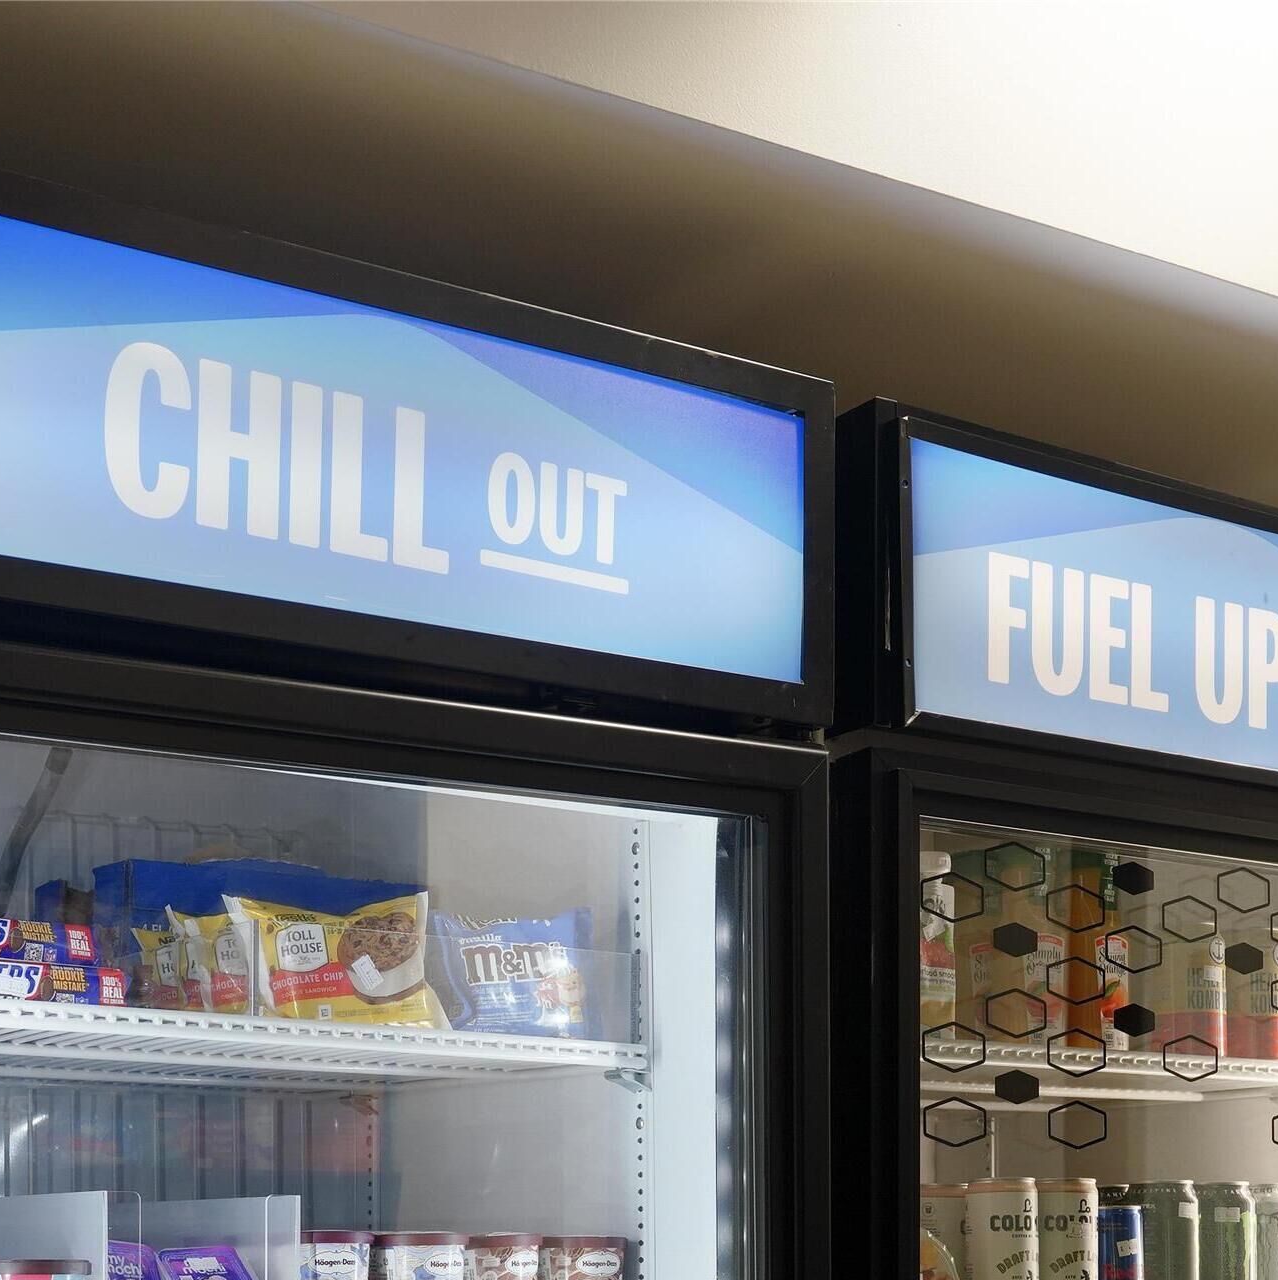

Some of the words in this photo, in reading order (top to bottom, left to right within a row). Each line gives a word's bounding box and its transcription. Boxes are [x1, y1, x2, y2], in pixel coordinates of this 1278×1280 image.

[104, 341, 450, 575] CHILL
[487, 451, 628, 564] OUT
[988, 552, 1169, 713] FUEL
[69, 930, 88, 940] 100%
[287, 930, 316, 943] TOLL
[71, 939, 90, 951] REAL
[281, 943, 323, 957] HOUSE
[52, 969, 85, 982] ROOKIE
[102, 976, 122, 986] 100%
[273, 974, 321, 991] CHOCOLATE
[323, 972, 344, 982] CHIP
[103, 987, 124, 999] REAL
[996, 1250, 1030, 1274] DRAFT
[1049, 1250, 1085, 1273] DRAFT
